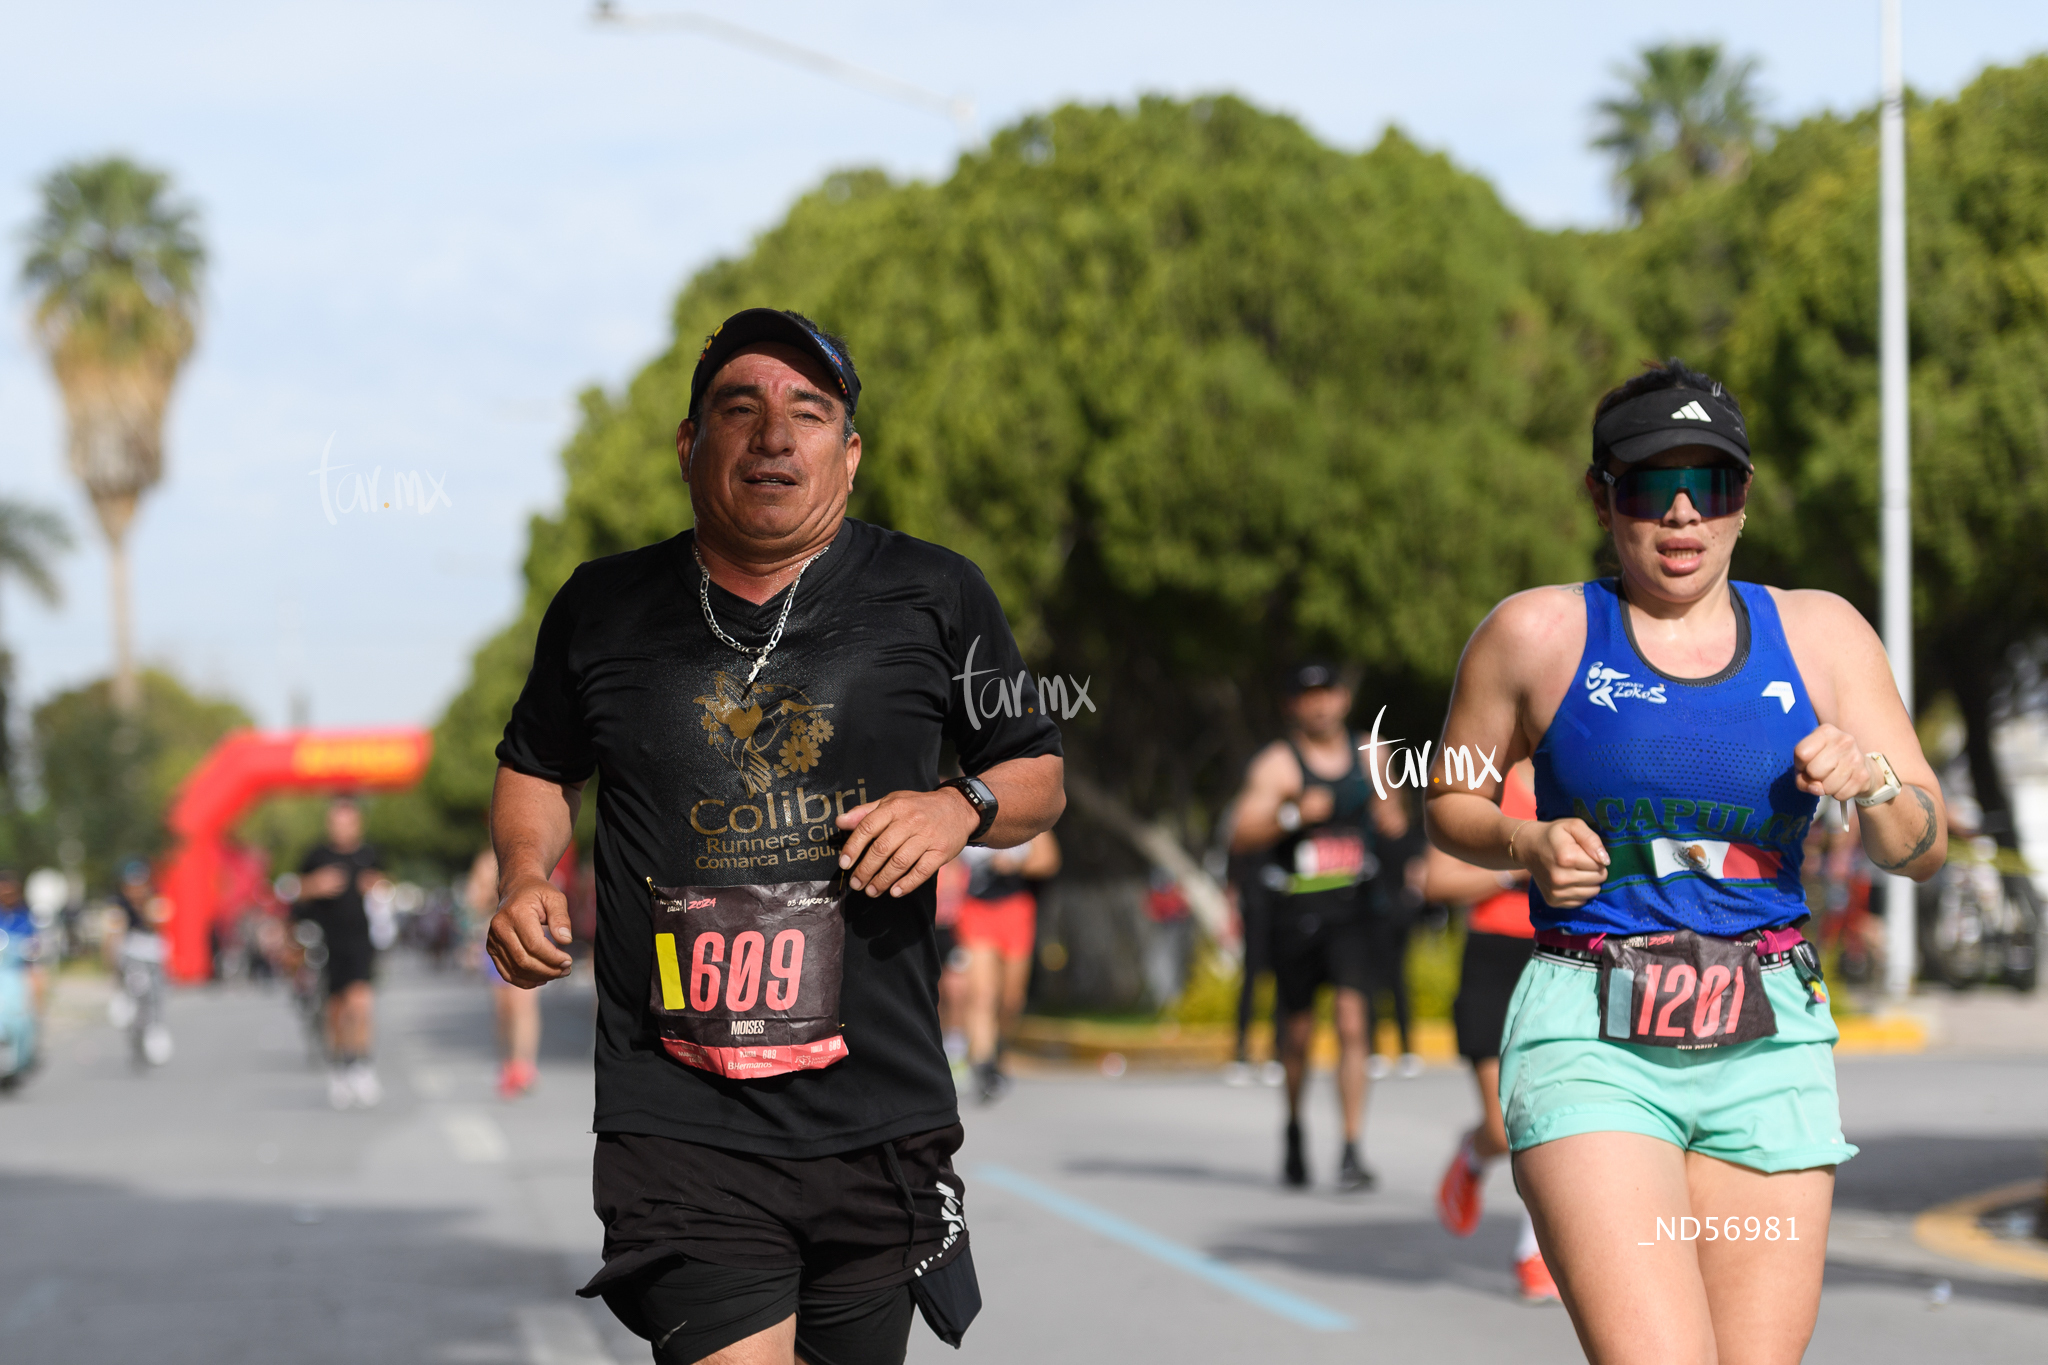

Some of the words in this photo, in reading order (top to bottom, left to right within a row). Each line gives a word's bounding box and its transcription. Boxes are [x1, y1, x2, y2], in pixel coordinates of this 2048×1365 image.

[690, 778, 867, 835] Colibri
[706, 832, 800, 854] Runners
[695, 854, 779, 870] Comarca
[786, 844, 842, 863] Lagun
[687, 897, 717, 910] 2024
[690, 928, 806, 1012] 609
[1637, 964, 1746, 1038] 1201
[731, 1020, 765, 1036] MOISES
